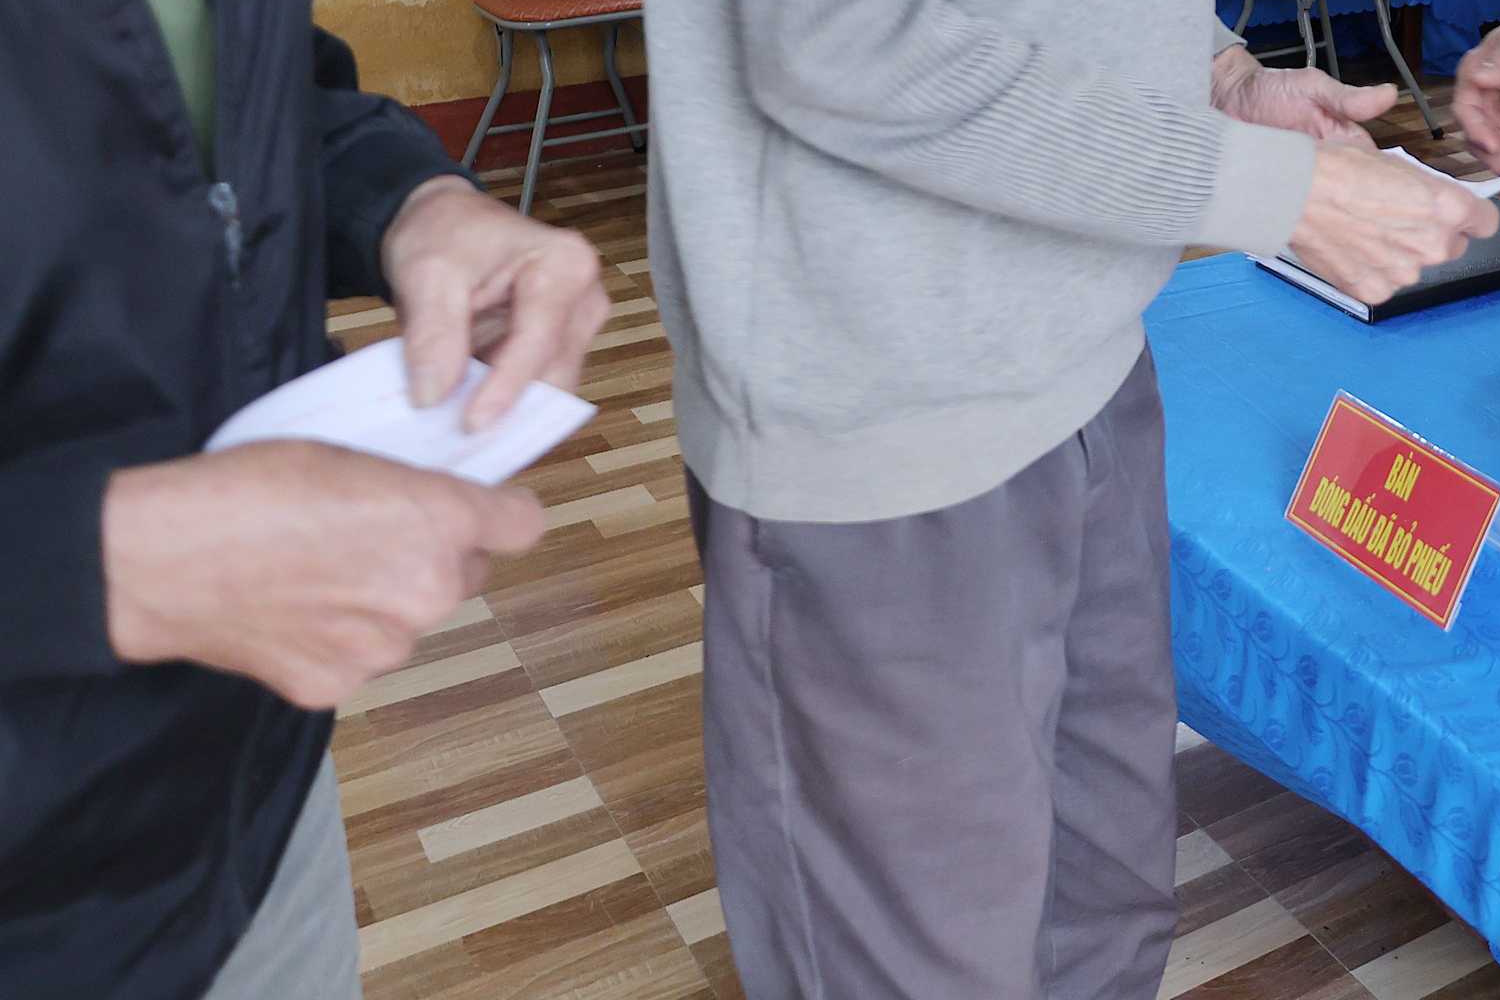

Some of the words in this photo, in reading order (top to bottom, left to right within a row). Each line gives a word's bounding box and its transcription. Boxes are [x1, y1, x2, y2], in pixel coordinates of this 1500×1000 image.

[1384, 451, 1422, 501] BÀN
[1309, 475, 1352, 528] ĐÓNG
[1341, 492, 1377, 545] DẤU
[1365, 513, 1398, 559] ĐÃ
[1383, 520, 1418, 571] BỎ
[1402, 539, 1453, 596] PHIẾU
